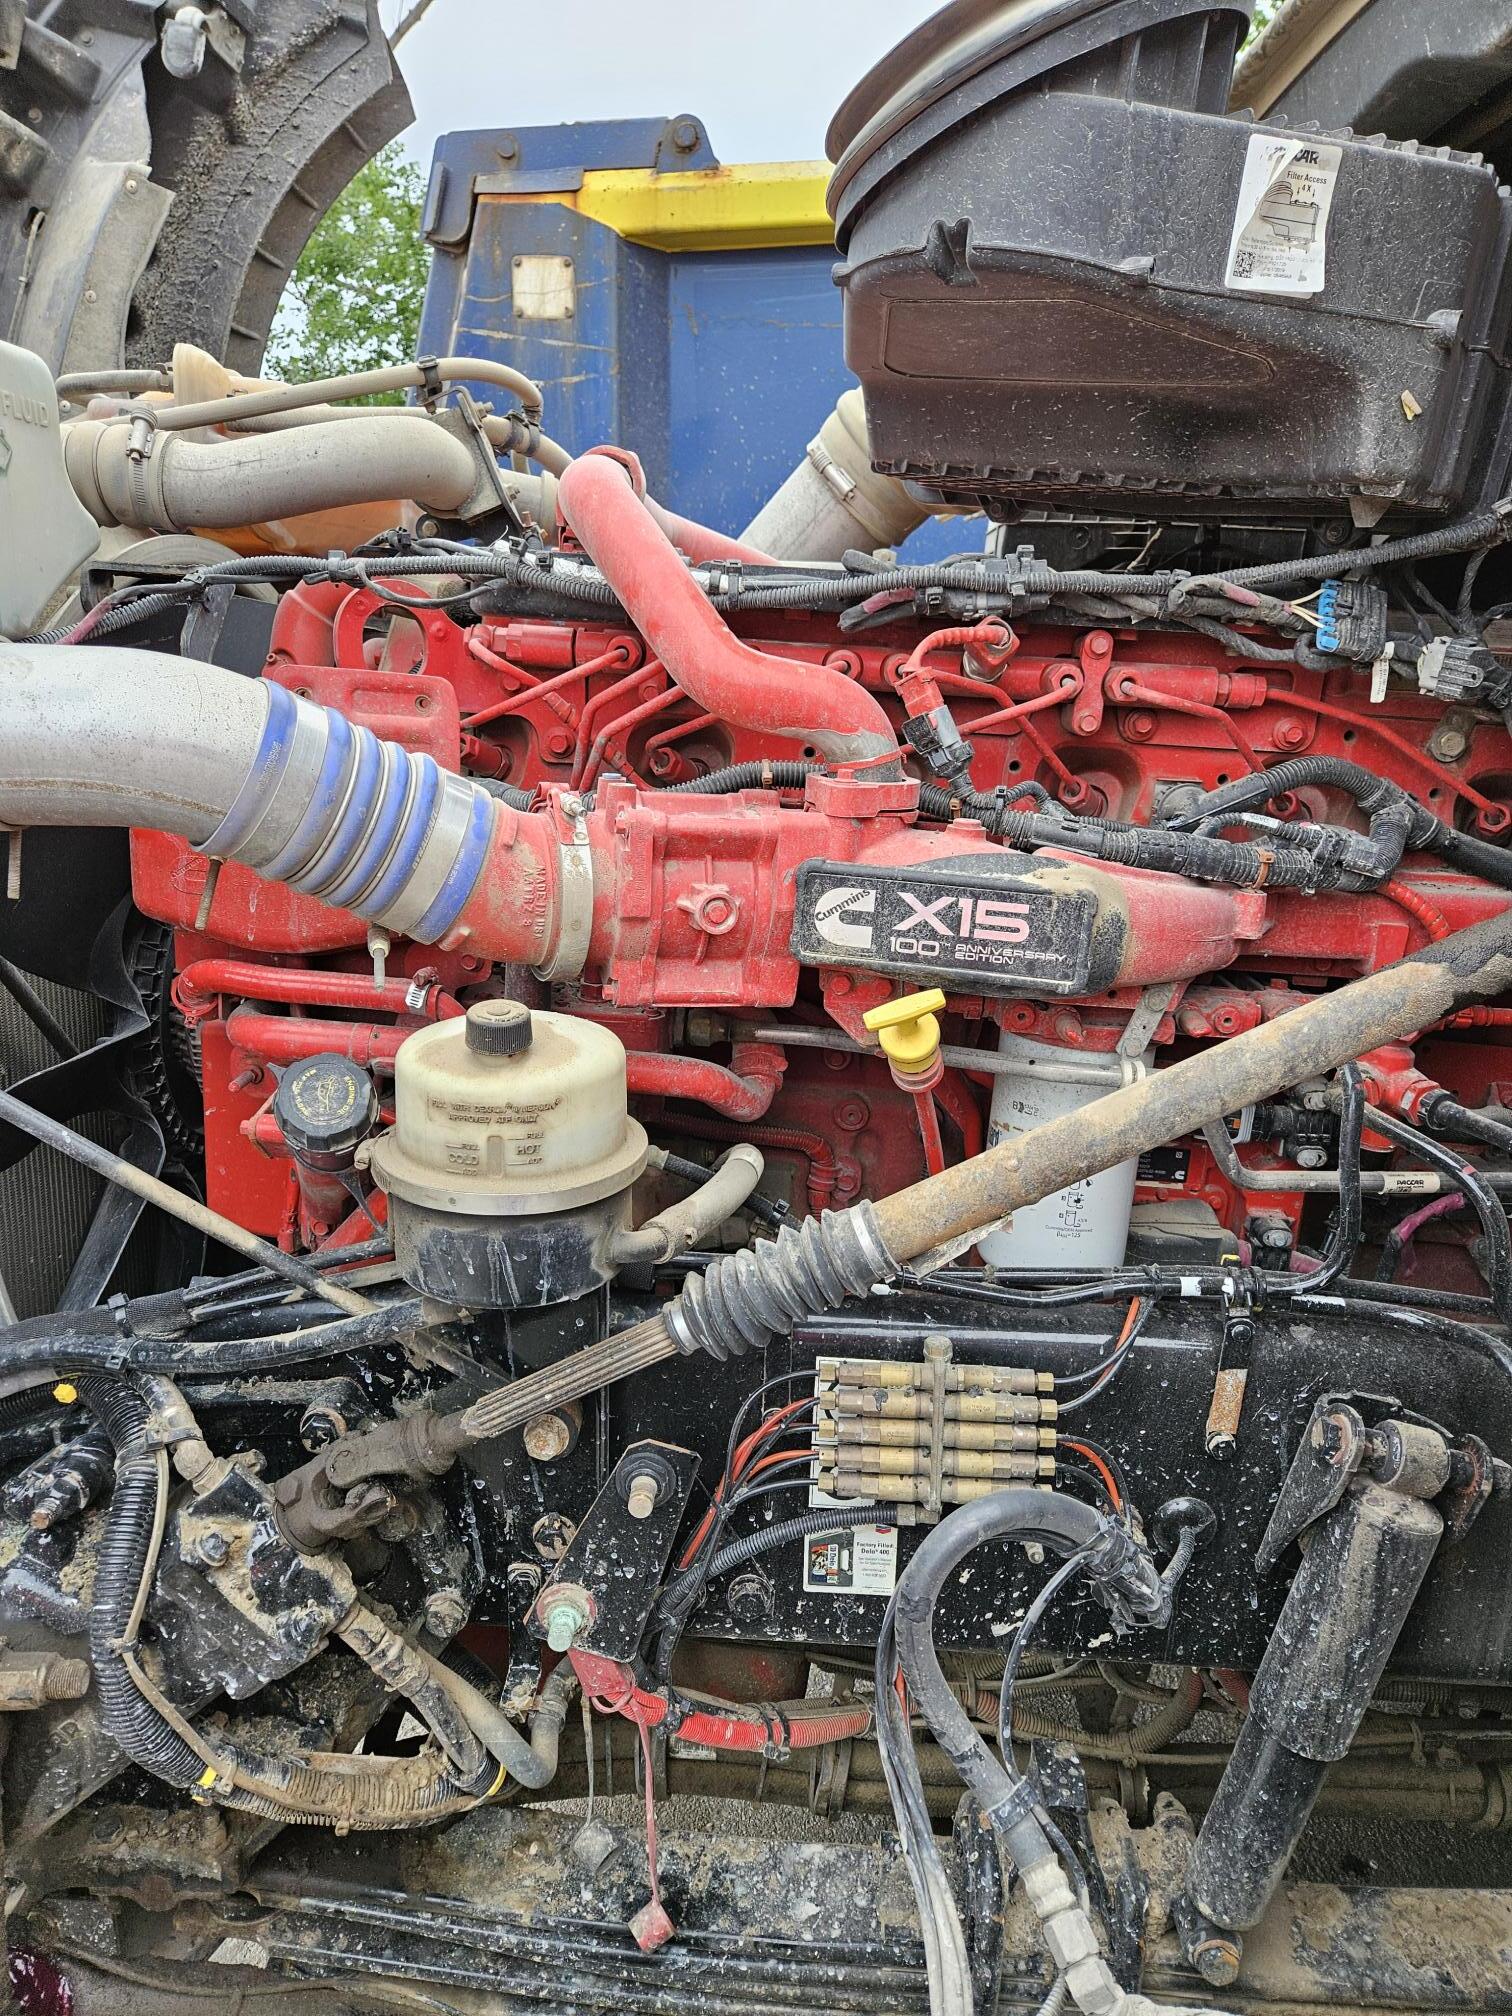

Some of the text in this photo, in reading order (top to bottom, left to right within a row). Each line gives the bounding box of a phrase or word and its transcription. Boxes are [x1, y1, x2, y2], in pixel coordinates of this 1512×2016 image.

[1286, 170, 1328, 185] Filter Access
[533, 865, 546, 939] MADE IN USA
[815, 888, 871, 922] Cummins
[892, 891, 1030, 943] X15
[954, 951, 1015, 965] EDITION
[955, 943, 1067, 963] ANNIVERSARY
[336, 1075, 355, 1116] ENGINE OIL
[448, 1114, 491, 1125] APPROVED
[514, 1114, 540, 1124] ONLY
[516, 1144, 541, 1156] HOT
[448, 1152, 480, 1166] COLD
[856, 1541, 877, 1549] Factory
